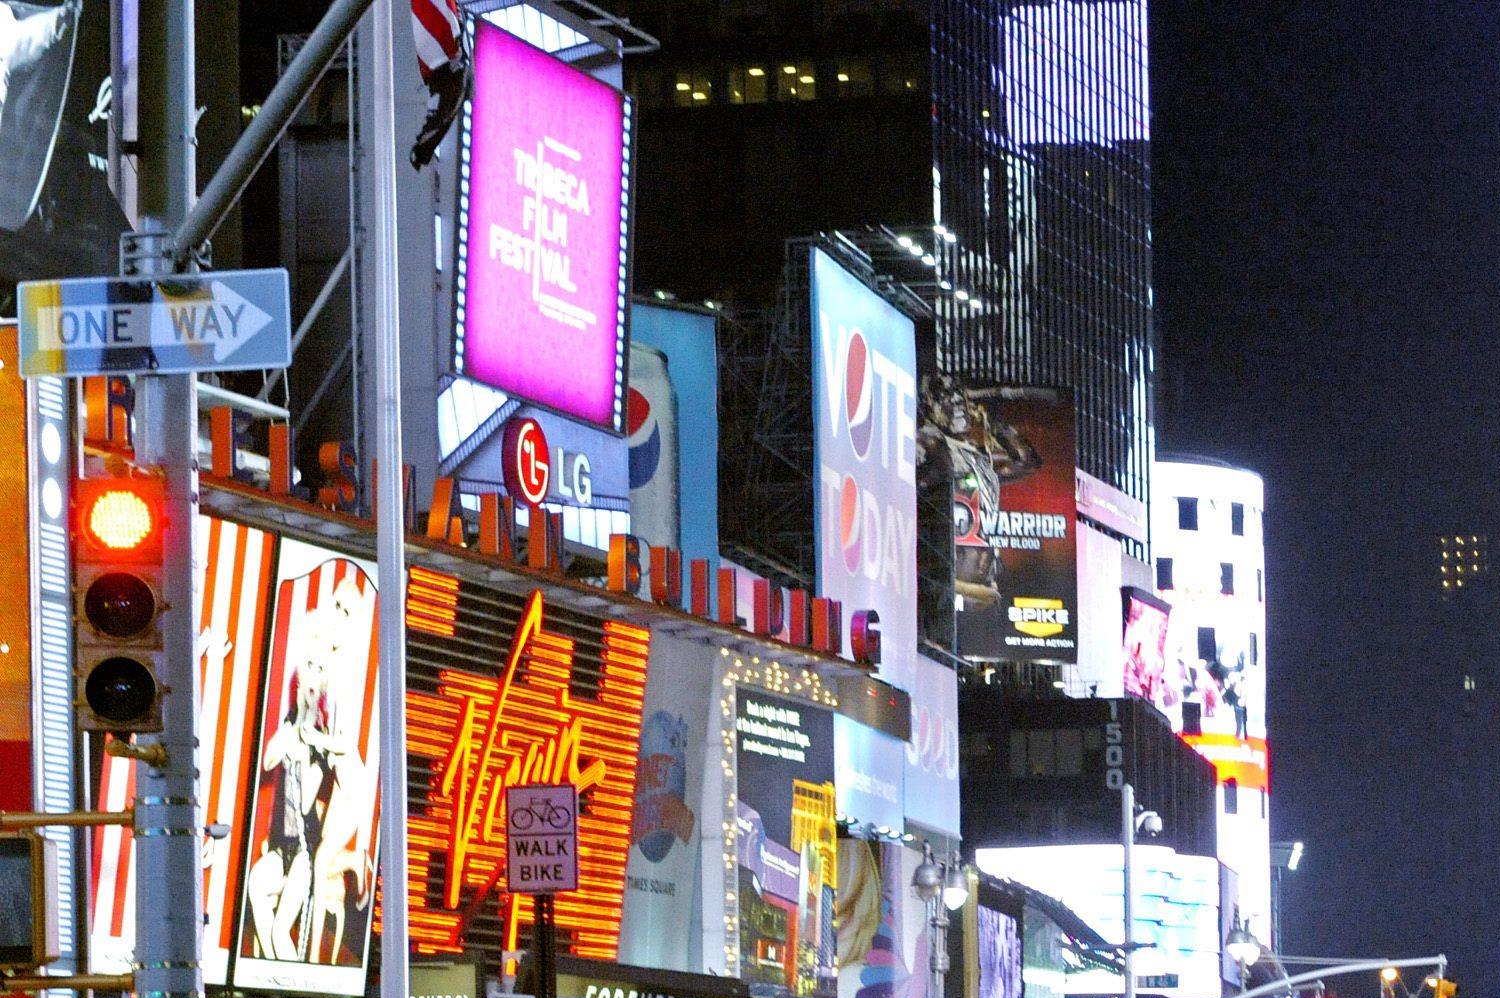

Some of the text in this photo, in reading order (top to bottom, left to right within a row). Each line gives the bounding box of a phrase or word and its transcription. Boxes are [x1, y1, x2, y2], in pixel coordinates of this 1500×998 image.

[58, 304, 246, 345] ONE WAY
[557, 446, 593, 504] LG
[979, 510, 1067, 539] WARRIOR
[988, 536, 1041, 550] NEW BLOOD
[607, 533, 882, 671] BUILDING
[1007, 606, 1070, 625] SPIKE
[1005, 636, 1021, 646] GET
[1046, 638, 1075, 649] ACTION
[514, 840, 569, 856] WALK
[520, 864, 564, 882] BIKE
